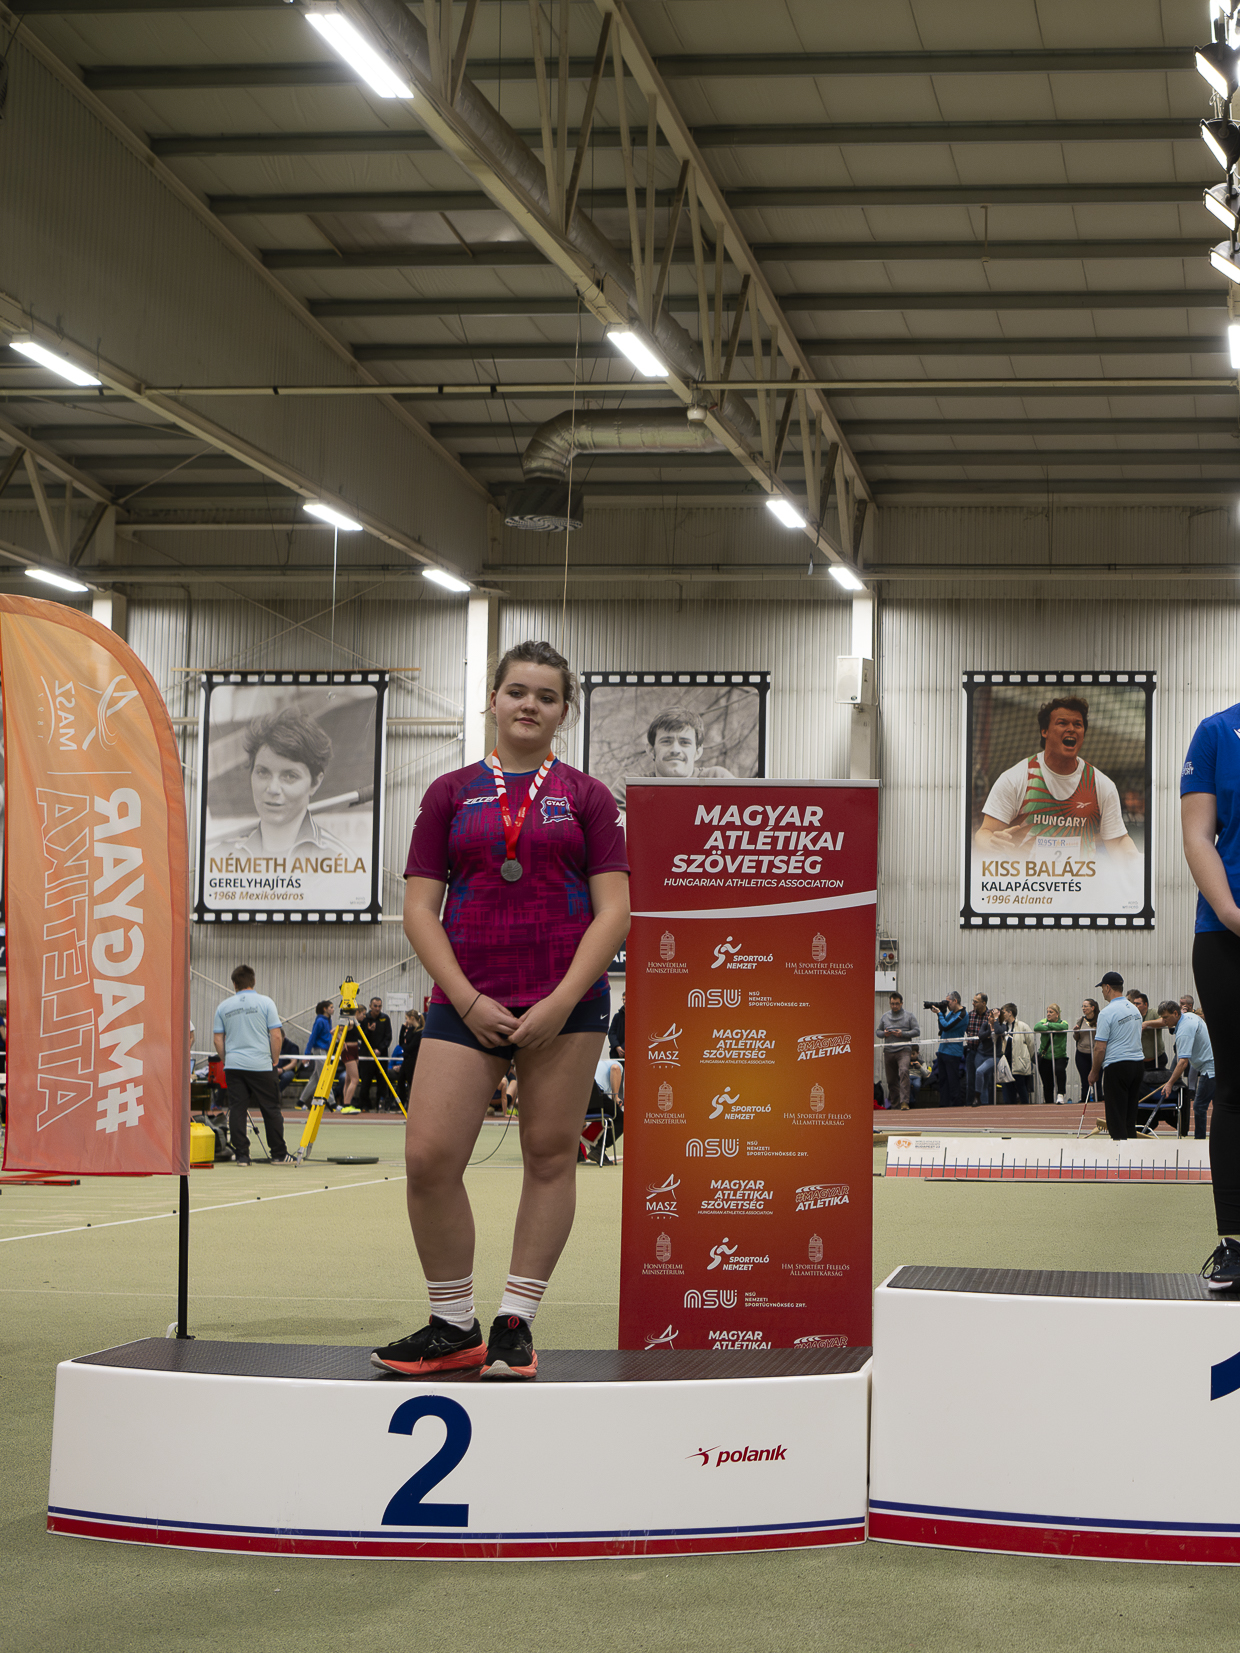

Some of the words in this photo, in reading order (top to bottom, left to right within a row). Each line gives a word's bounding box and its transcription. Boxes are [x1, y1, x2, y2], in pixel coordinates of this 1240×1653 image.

[694, 805, 823, 827] MAGYAR
[1033, 814, 1087, 827] HUNGARY
[704, 826, 844, 851] ATLÉTIKAI
[209, 853, 286, 874] NÉMETH
[290, 853, 367, 874] ANGÉLA
[671, 850, 823, 874] SZÖVETSÉG
[981, 860, 1020, 877] KISS
[1025, 857, 1096, 877] BALÁZS
[209, 876, 301, 890] GERELYHAJÍTÁS
[664, 878, 724, 887] HUNGARIAN
[725, 878, 777, 888] ATHLETICS
[778, 879, 844, 888] ASSOCIATION
[981, 879, 1082, 892] KALAPÁCSVETÉS
[213, 891, 236, 900] 1968
[239, 890, 304, 900] Mexikóváros
[986, 895, 1011, 904] 1996
[1012, 895, 1053, 904] Atlanta
[733, 953, 774, 962] SPORTOLÓ
[712, 1029, 767, 1039] MAGYAR
[716, 1038, 775, 1049] ATLÉTIKAI
[648, 1051, 679, 1060] MASZ
[702, 1048, 766, 1059] SZÖVETSÉG
[731, 1104, 772, 1112] SPORTOLÓ
[710, 1180, 765, 1190] MAGYAR
[714, 1188, 774, 1200] ATLÉTIKAI
[646, 1201, 677, 1211] MASZ
[700, 1198, 764, 1209] SZÖVETSÉG
[729, 1255, 770, 1263] SPORTOLÓ
[708, 1330, 763, 1341] MAGYAR
[712, 1339, 772, 1350] ATLÉTIKAI
[381, 1394, 472, 1528] 2
[715, 1444, 787, 1467] polanik
